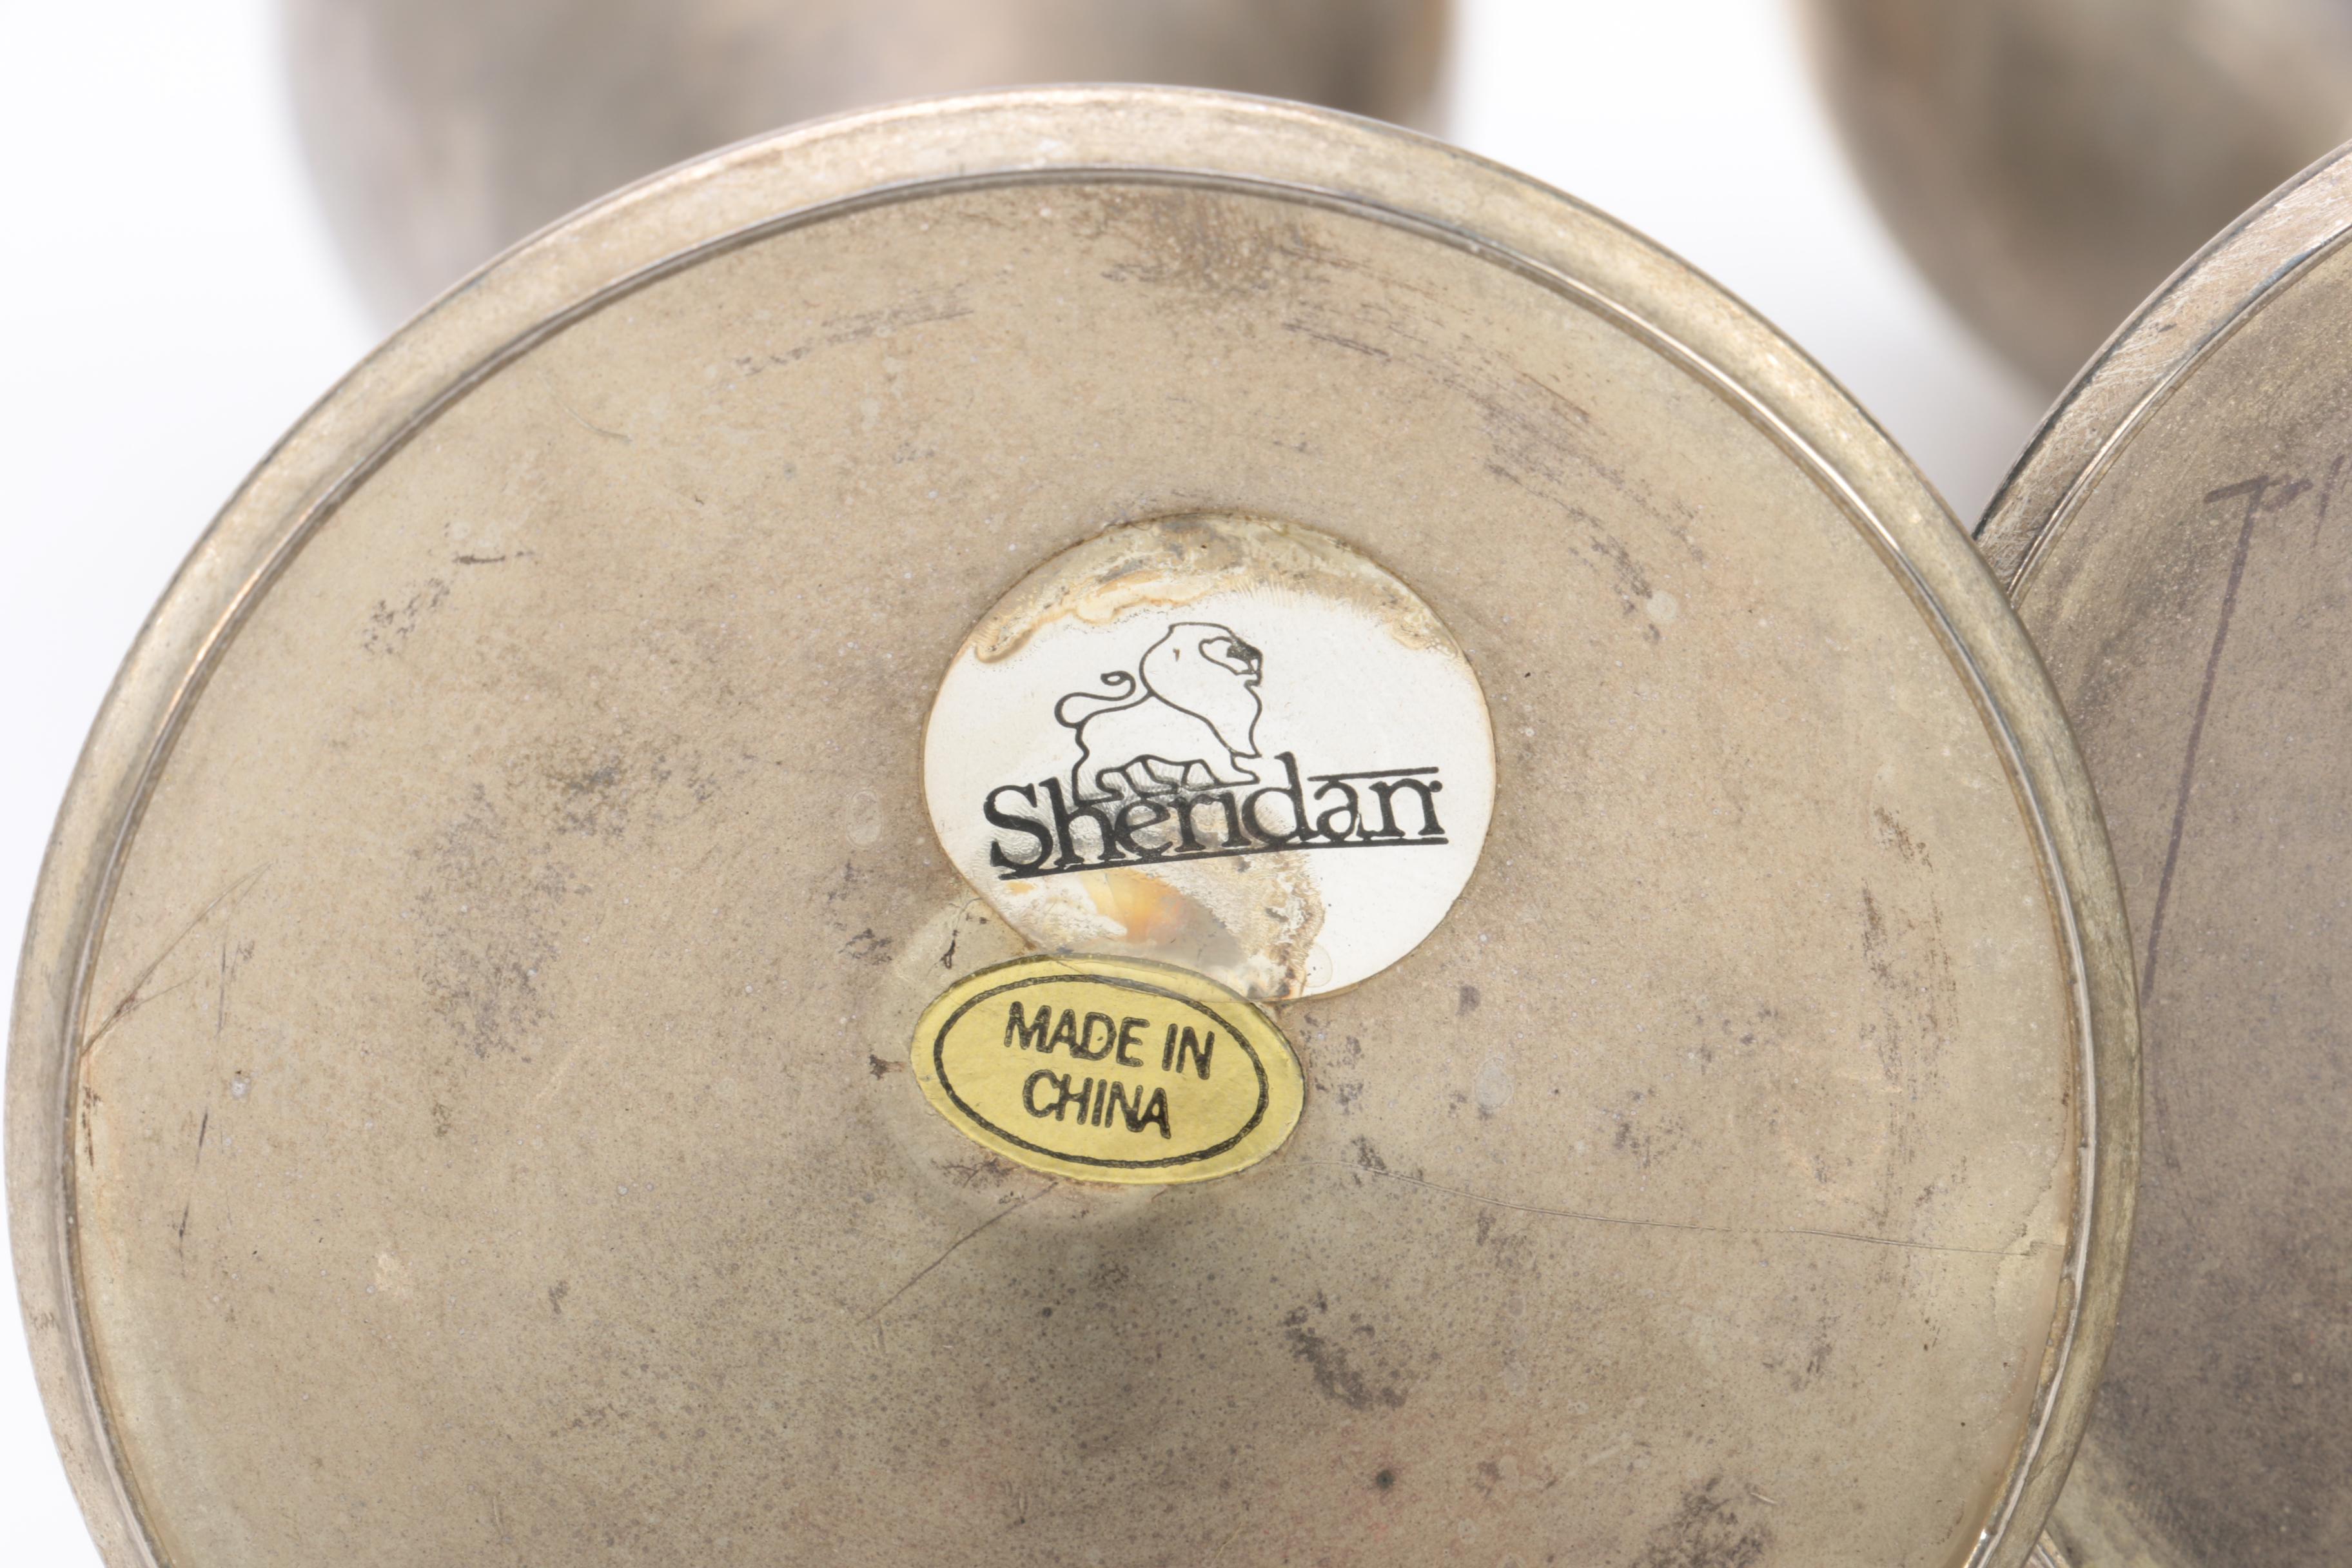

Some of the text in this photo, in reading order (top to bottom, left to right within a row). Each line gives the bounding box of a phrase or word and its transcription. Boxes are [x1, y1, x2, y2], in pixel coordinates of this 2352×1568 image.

[984, 752, 1446, 872] Sheridan
[1004, 1001, 1216, 1081] MADE IN
[1022, 1068, 1172, 1140] CHINA
